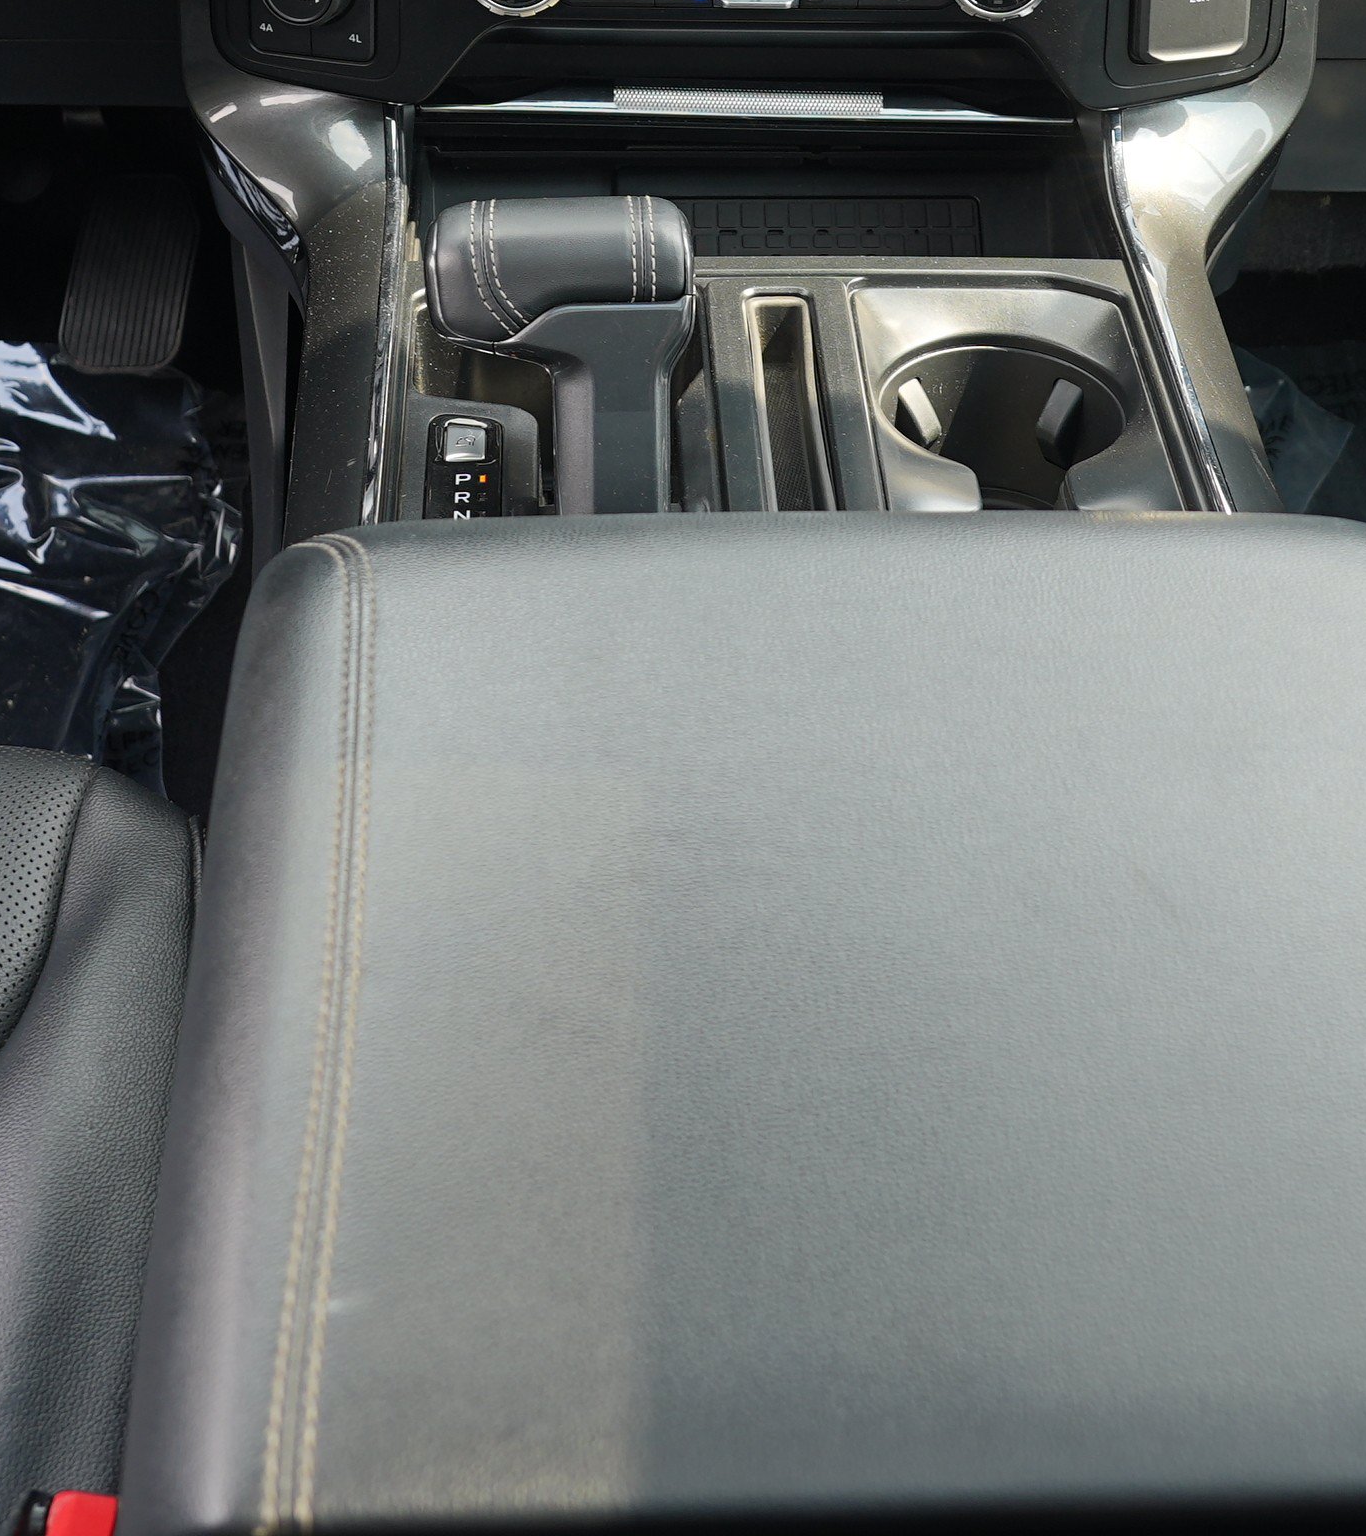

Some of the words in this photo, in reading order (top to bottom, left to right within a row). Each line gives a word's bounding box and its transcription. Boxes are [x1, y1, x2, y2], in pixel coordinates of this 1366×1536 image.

[259, 22, 274, 33] 4A
[348, 33, 362, 44] 4L
[455, 473, 471, 485] P
[454, 491, 471, 503] R
[453, 510, 470, 520] N
